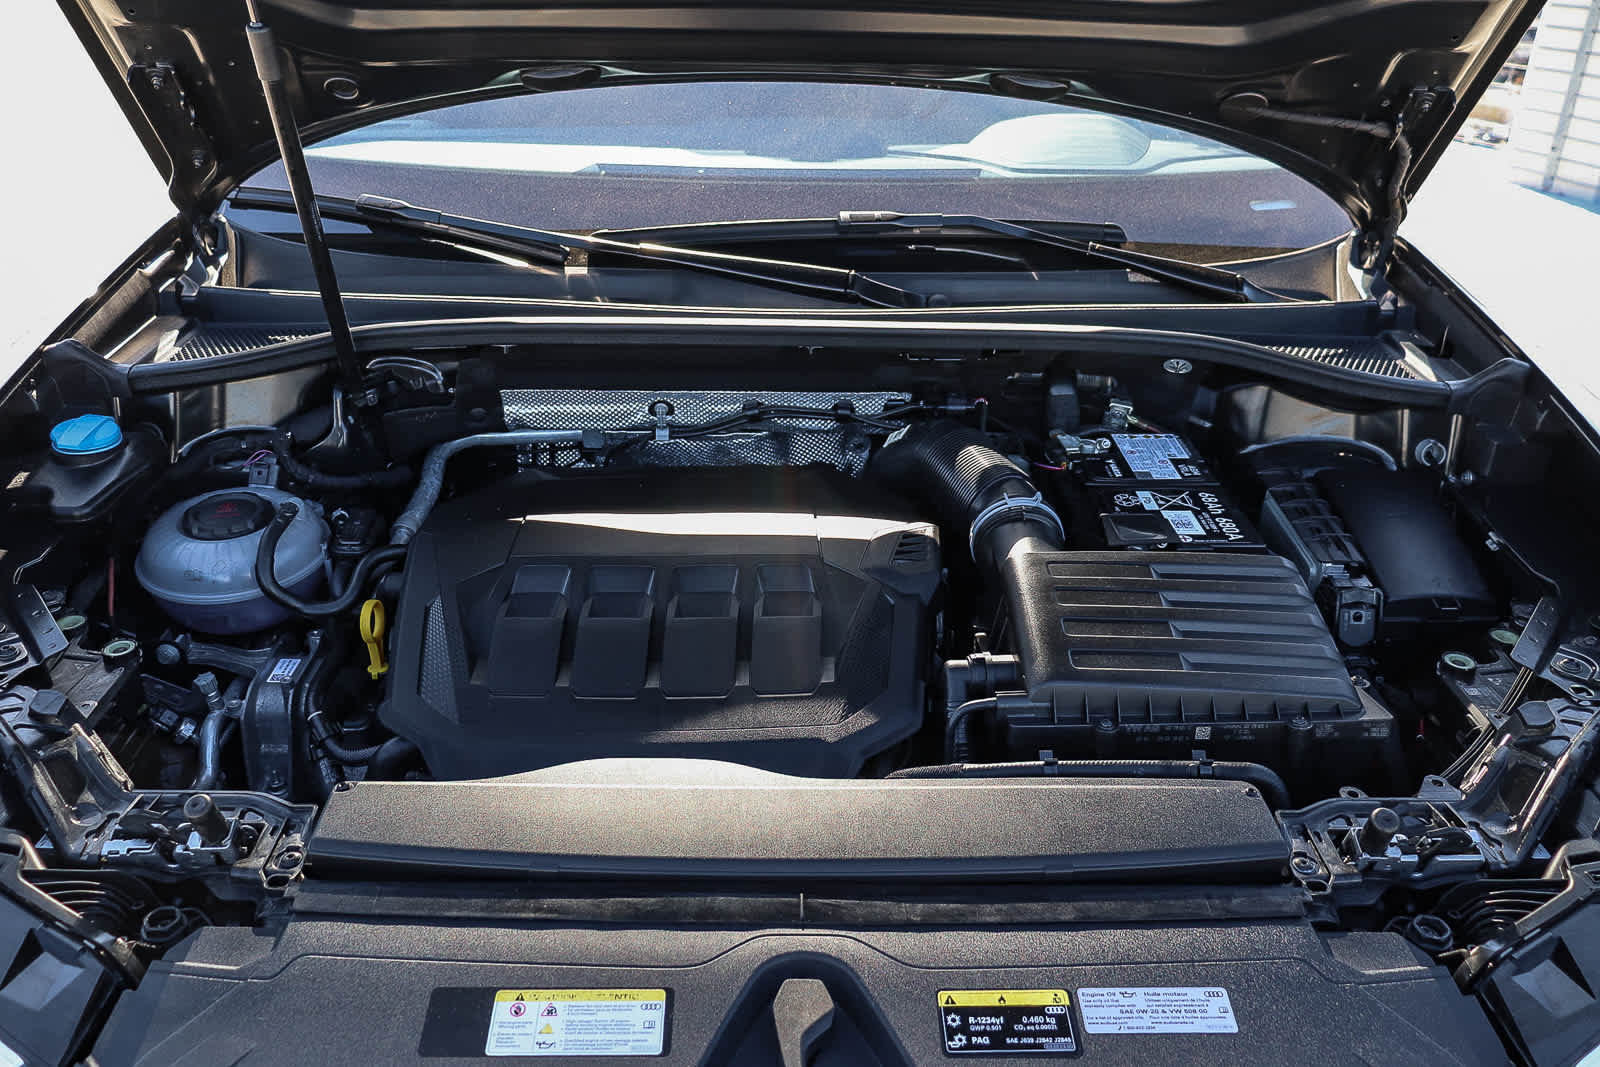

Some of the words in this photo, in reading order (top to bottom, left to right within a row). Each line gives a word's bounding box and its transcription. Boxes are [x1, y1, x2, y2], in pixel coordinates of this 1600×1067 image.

[1197, 492, 1226, 514] 68Ah
[1214, 517, 1245, 541] 680A
[1045, 1016, 1056, 1024] kg
[971, 1036, 990, 1044] PAG
